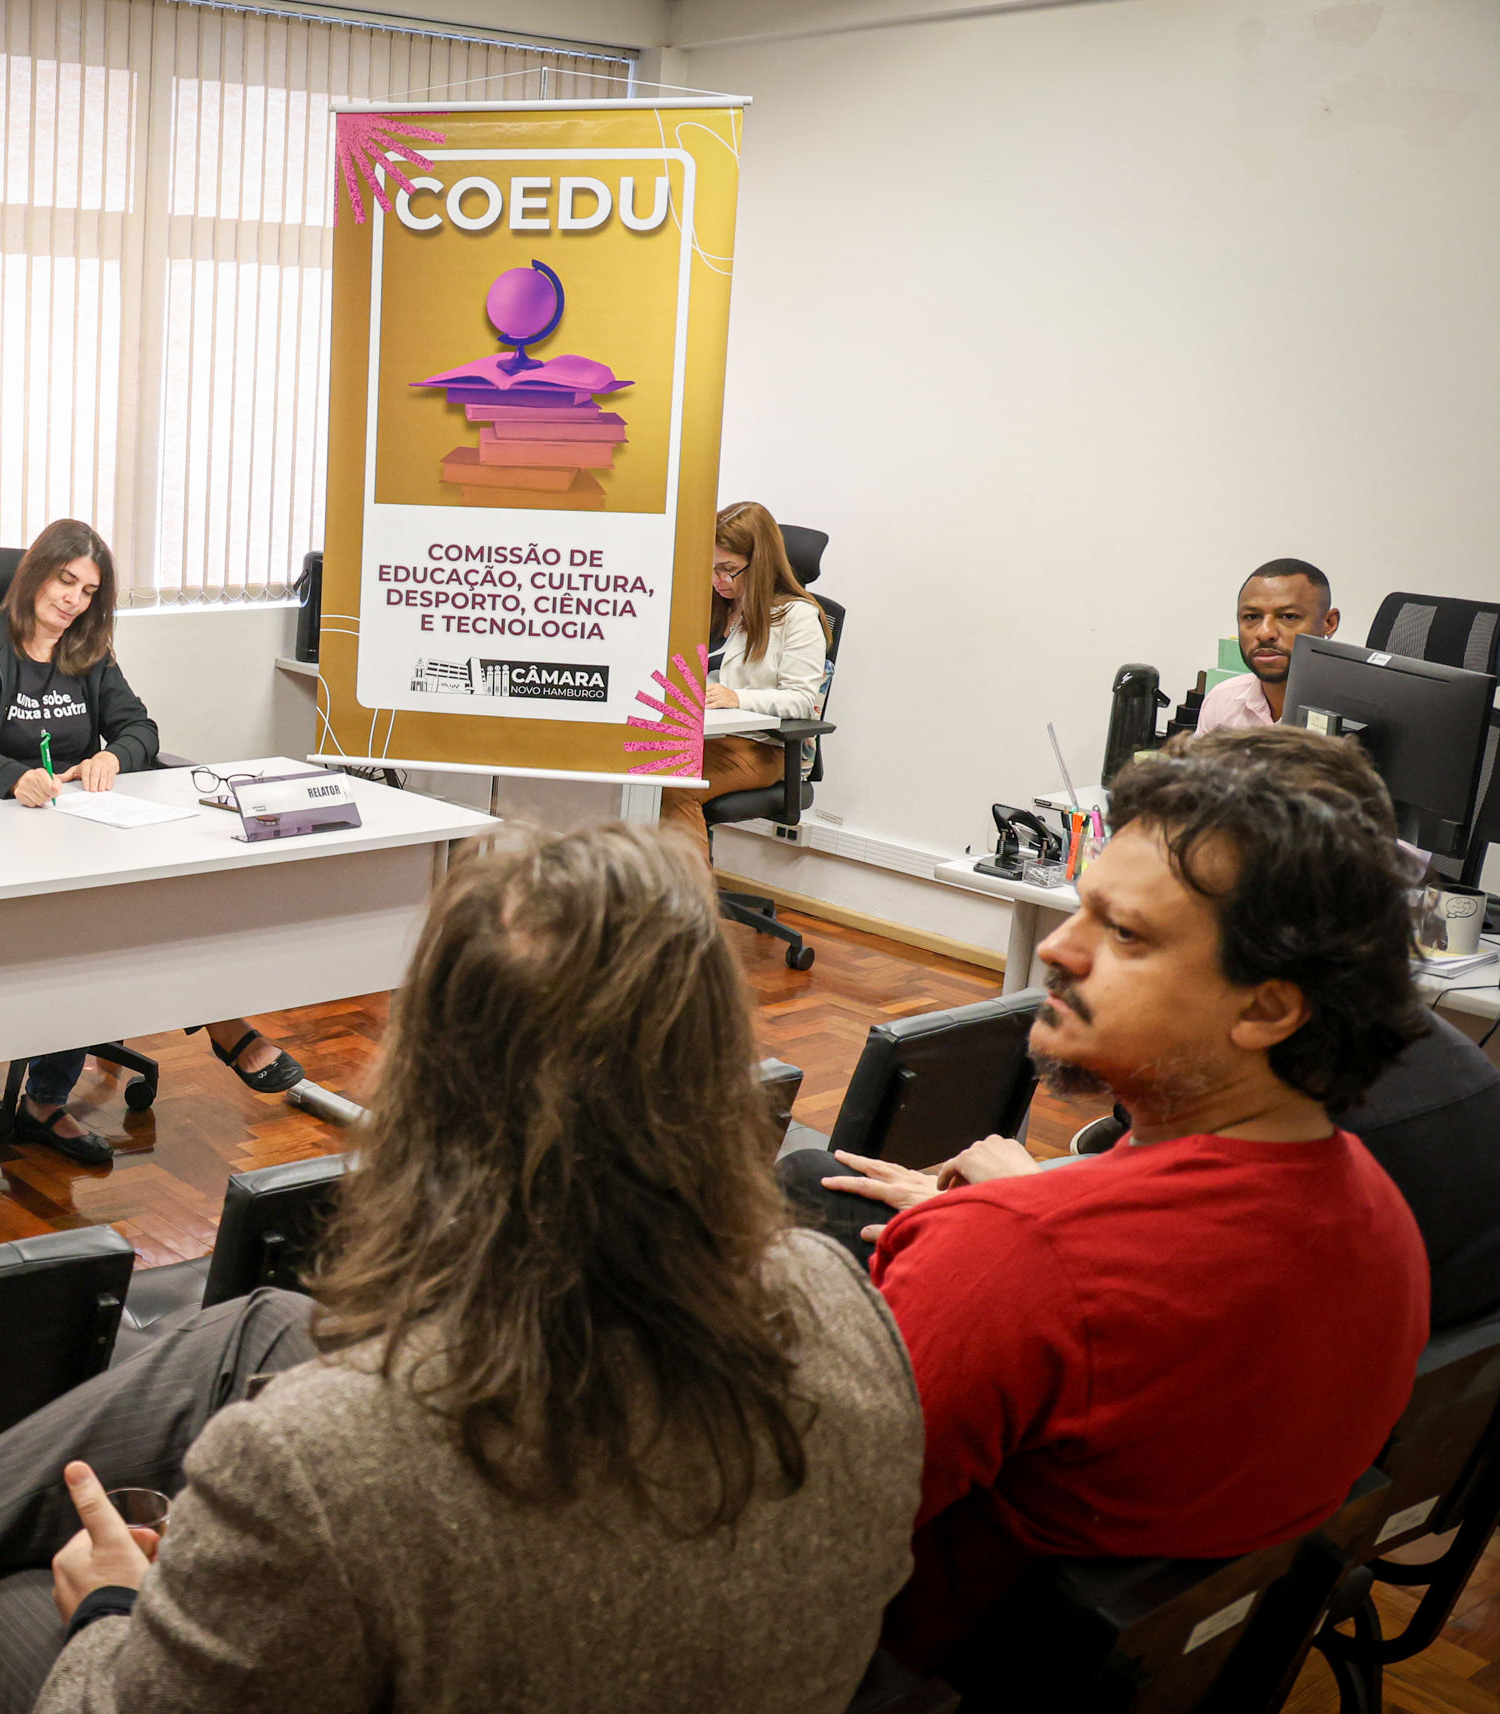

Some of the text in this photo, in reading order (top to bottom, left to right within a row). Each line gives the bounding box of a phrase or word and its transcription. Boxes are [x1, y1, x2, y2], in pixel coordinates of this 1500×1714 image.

[395, 176, 670, 231] COEDU
[427, 543, 604, 568] COMISSÃO DE
[378, 564, 655, 598] EDUCAÇÃO, CULTURA,
[386, 588, 637, 618] DESPORTO, CIÊNCIA
[421, 614, 605, 640] E TECNOLOGIA
[511, 665, 604, 687] CÂMARA
[17, 690, 72, 708] uma sobe
[511, 685, 604, 698] NOVO HAMBURGO
[7, 702, 86, 720] puxa a outra
[307, 785, 341, 798] RELATOR
